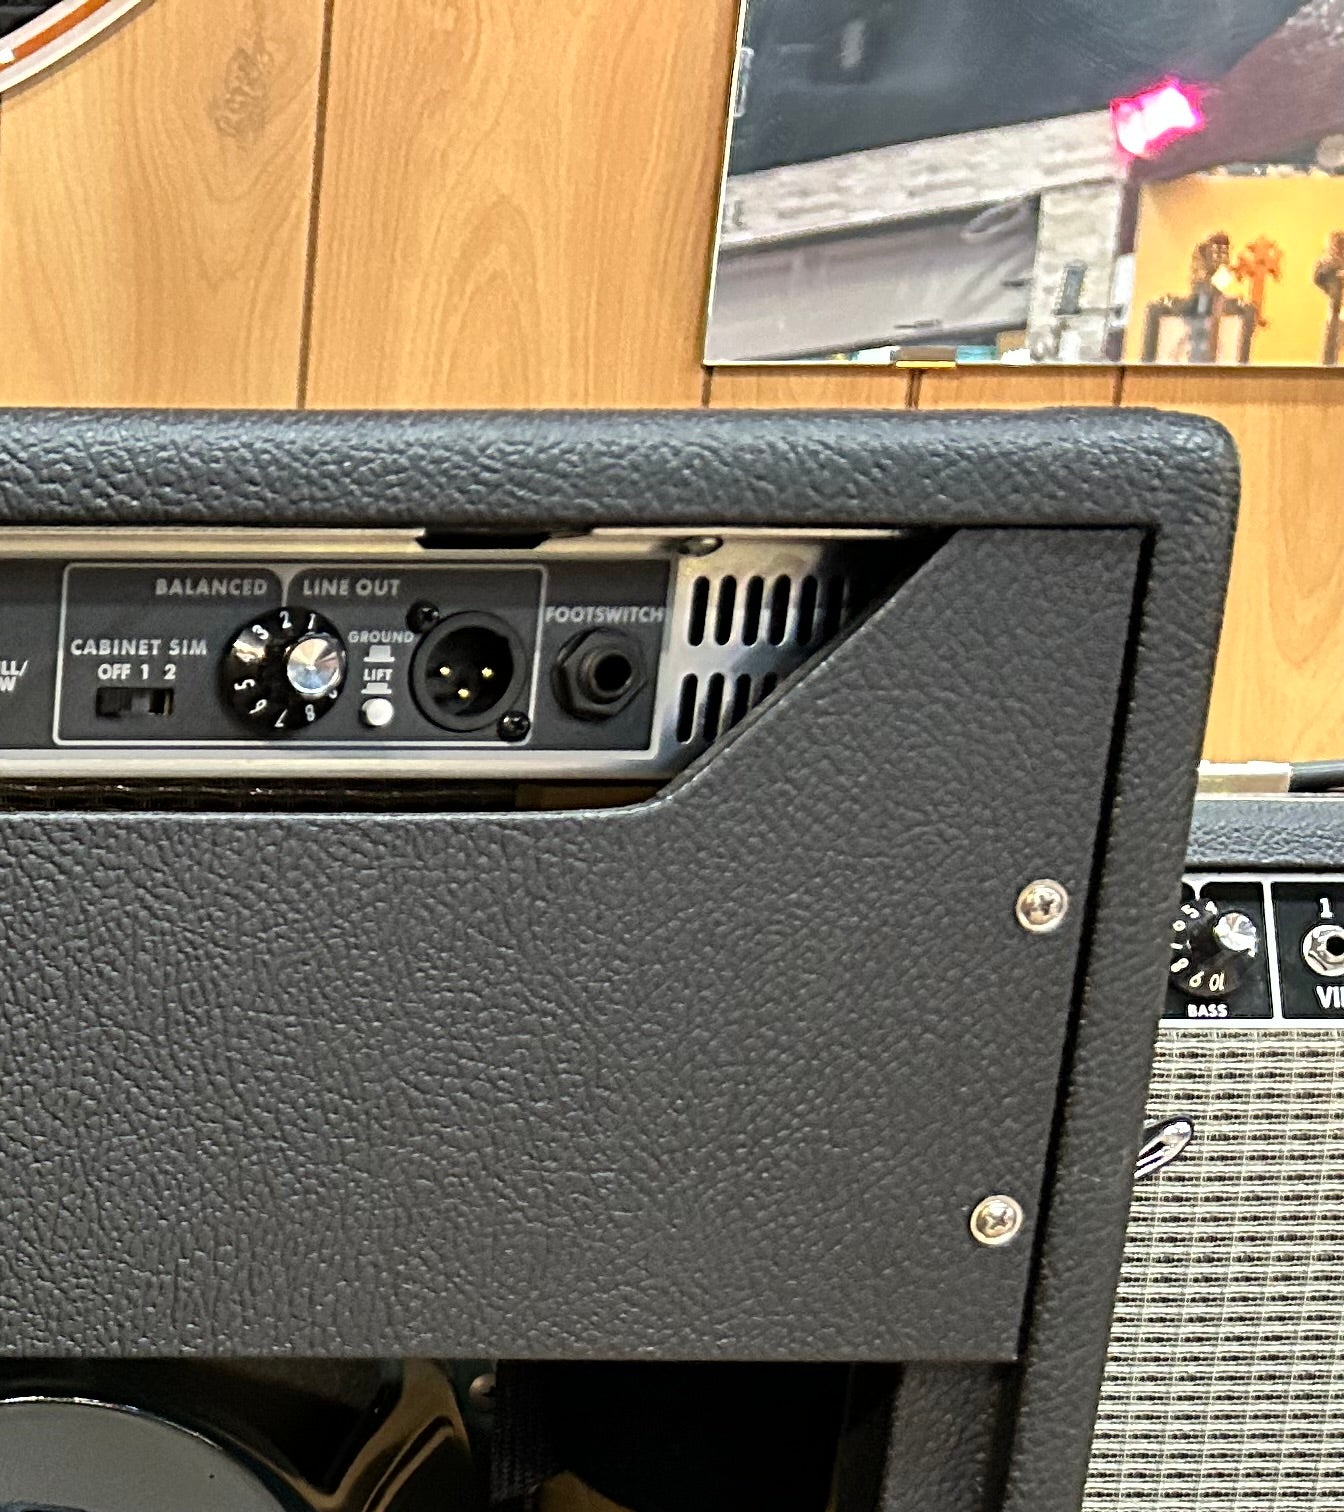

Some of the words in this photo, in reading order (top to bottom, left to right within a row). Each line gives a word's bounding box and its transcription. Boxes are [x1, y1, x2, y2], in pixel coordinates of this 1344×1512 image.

[154, 578, 269, 598] BALANCED
[302, 578, 350, 597] LINE
[355, 578, 401, 597] OUT
[545, 604, 665, 624] FOOTSWITCH
[348, 630, 415, 644] GROUND
[70, 640, 163, 657] CABINET
[168, 640, 208, 657] SIM
[97, 664, 131, 680] OFF
[140, 664, 150, 680] 1
[163, 664, 177, 681] 2
[363, 669, 393, 681] LIFT
[1320, 898, 1334, 918] 1
[1187, 1003, 1228, 1018] BASS
